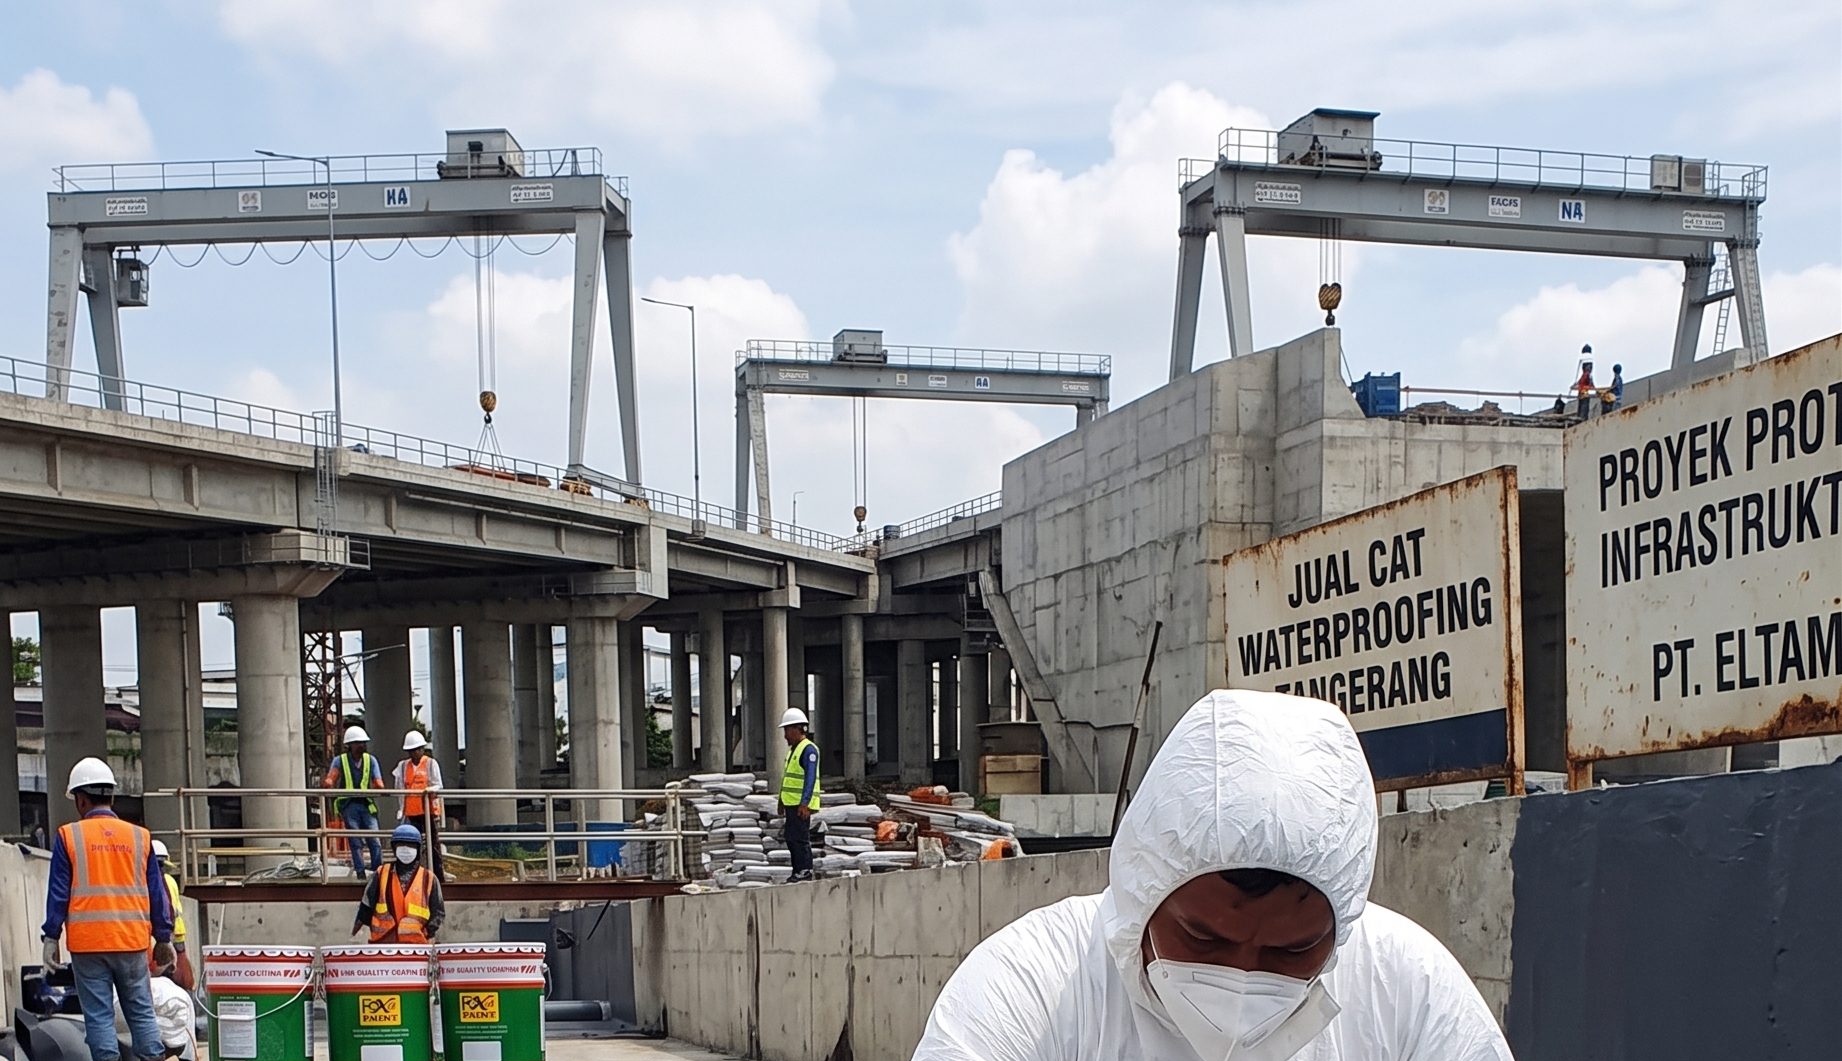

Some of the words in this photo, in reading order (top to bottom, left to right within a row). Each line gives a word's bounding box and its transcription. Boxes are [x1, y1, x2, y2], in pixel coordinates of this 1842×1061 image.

[1600, 416, 1734, 512] PROYEK
[1288, 550, 1359, 609] JUAL
[1368, 527, 1425, 588] CAT
[1601, 471, 1842, 589] INFRASTRUKT
[1238, 576, 1492, 677] WATERPROOFING
[1653, 637, 1701, 702] PT.
[1715, 611, 1842, 693] ELTAM
[1275, 651, 1451, 715] NGERANG
